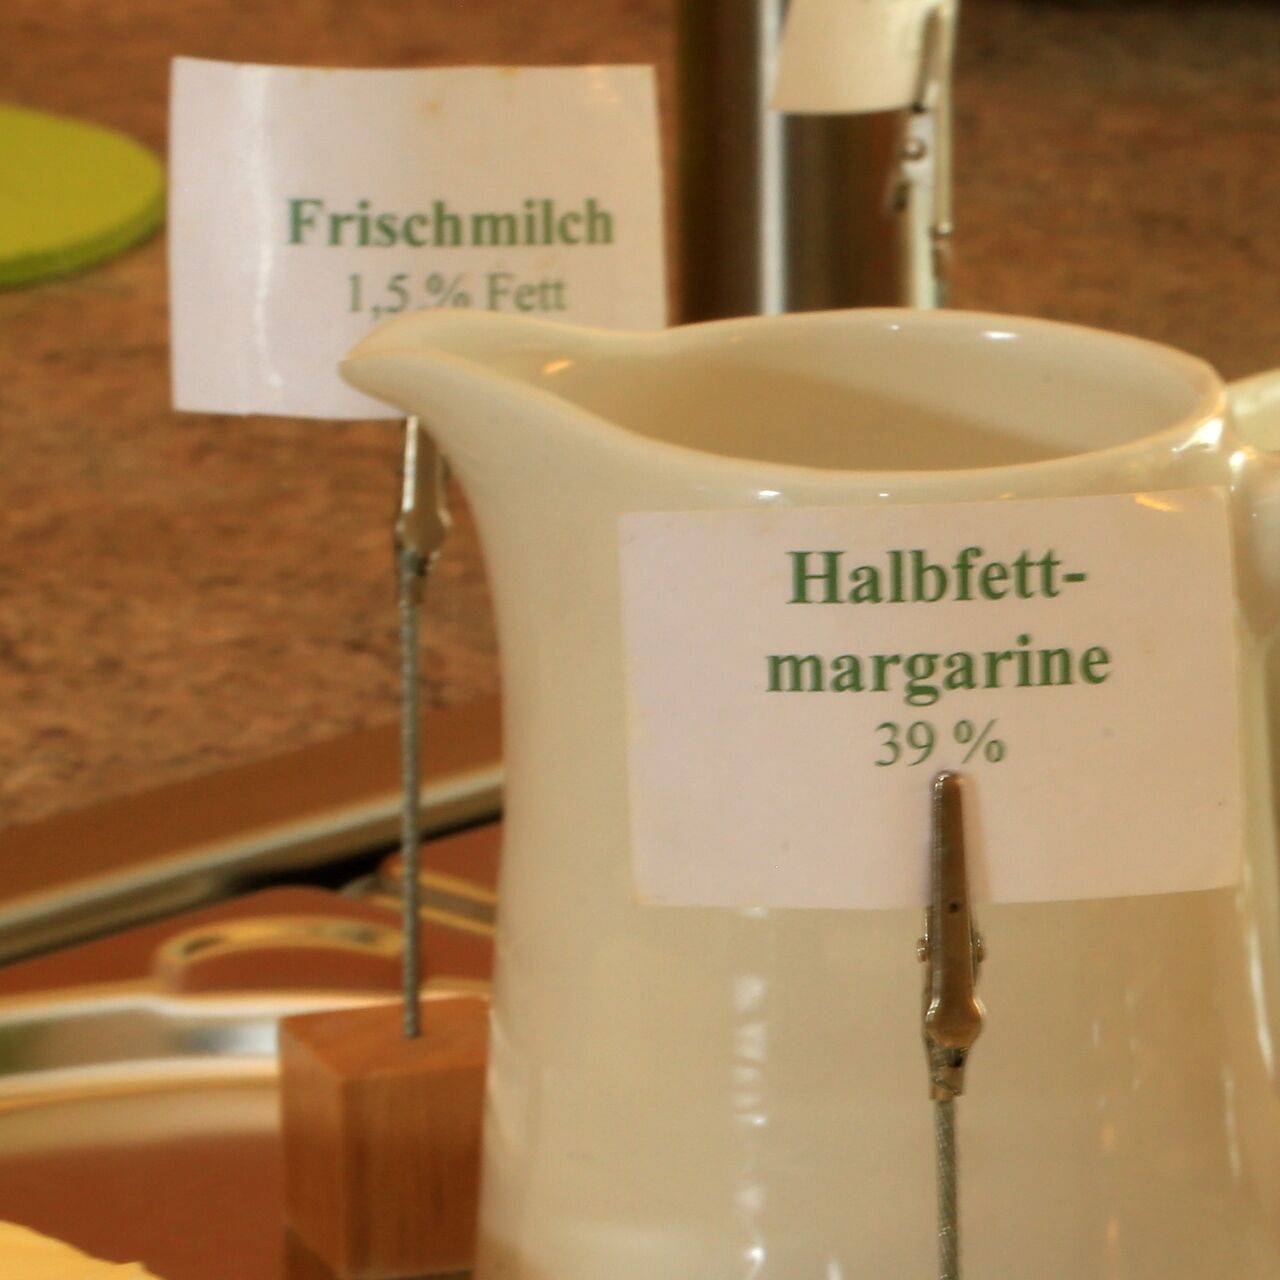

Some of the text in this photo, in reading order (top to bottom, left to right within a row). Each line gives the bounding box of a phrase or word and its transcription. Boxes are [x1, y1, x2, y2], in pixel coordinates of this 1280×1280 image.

[287, 198, 615, 247] Frischmilch
[347, 273, 410, 321] 1,5
[486, 272, 568, 313] Fett
[785, 546, 1088, 605] Halbfett-
[765, 634, 1112, 707] margarine
[873, 719, 1007, 767] 39 %
